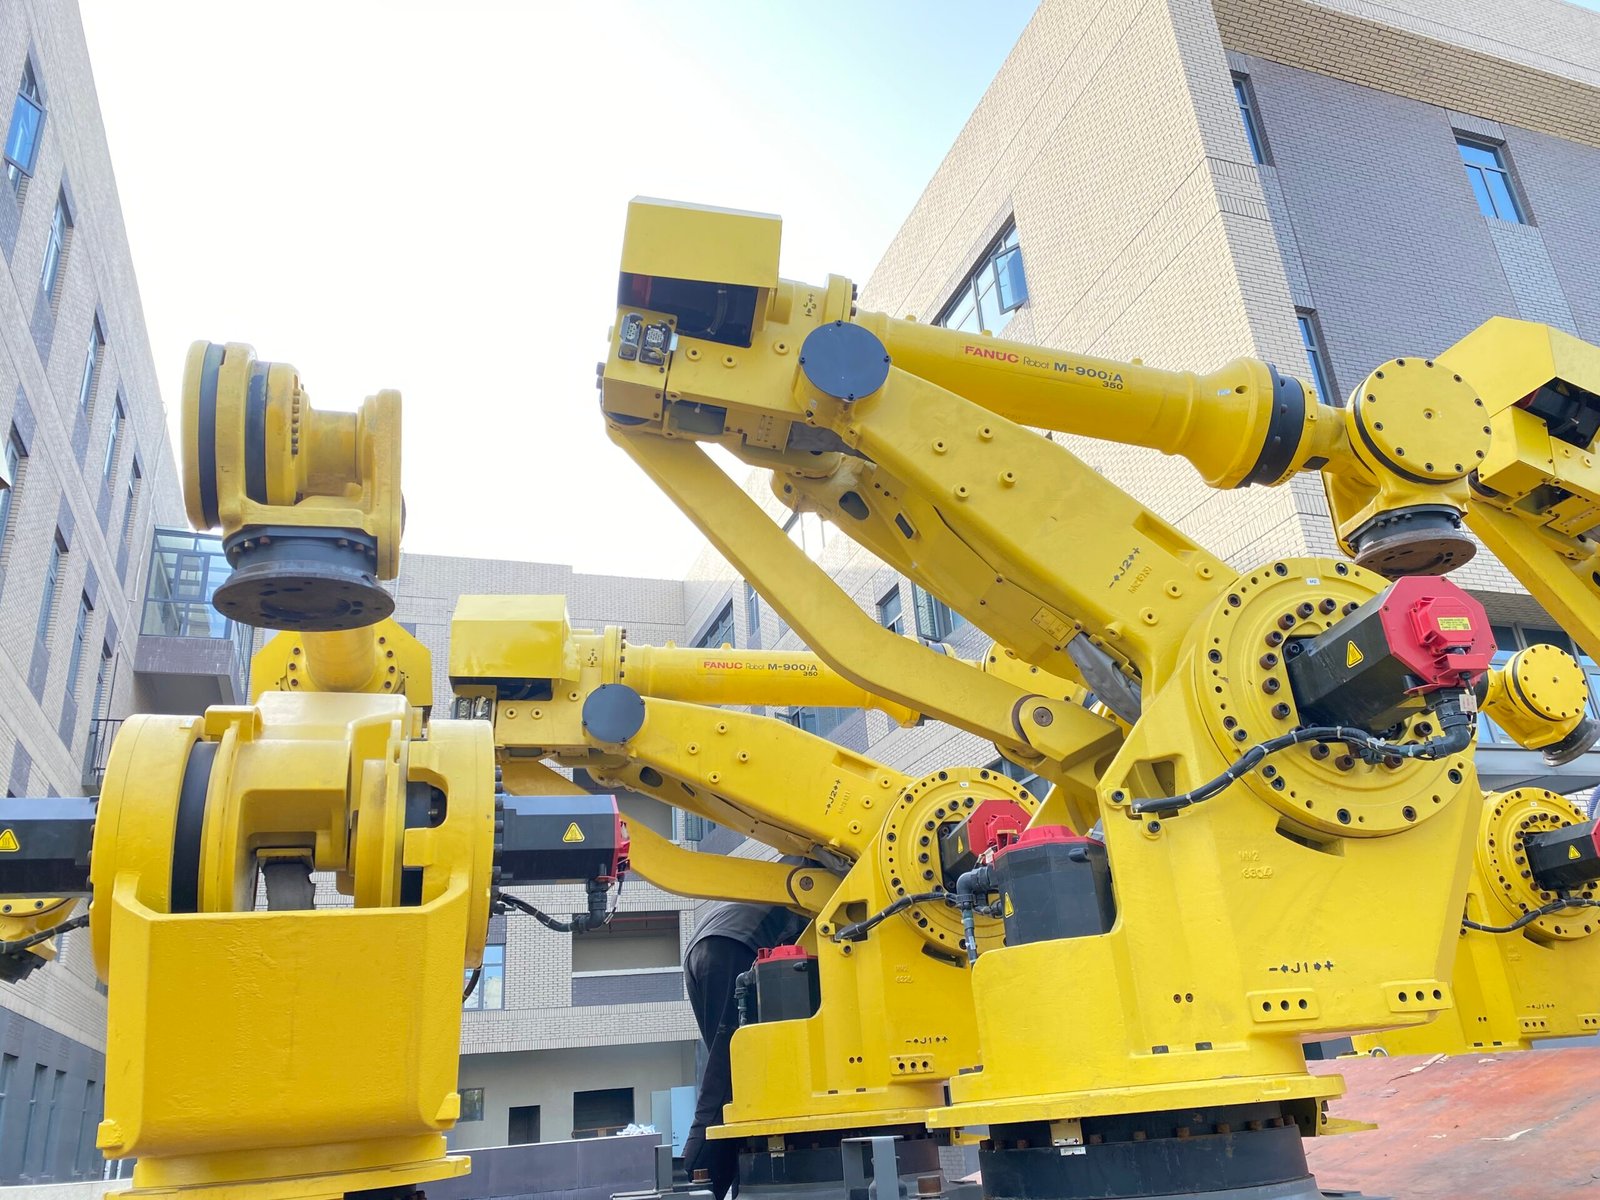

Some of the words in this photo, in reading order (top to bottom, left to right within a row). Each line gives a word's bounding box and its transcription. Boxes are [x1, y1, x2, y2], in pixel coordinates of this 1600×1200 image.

[964, 345, 1020, 364] FANUC
[1023, 356, 1050, 370] Robot
[1054, 362, 1124, 383] M-900iA
[1102, 380, 1124, 390] 350
[703, 661, 743, 670] FANUC
[745, 662, 766, 671] Robot
[767, 663, 818, 671] M-900iA
